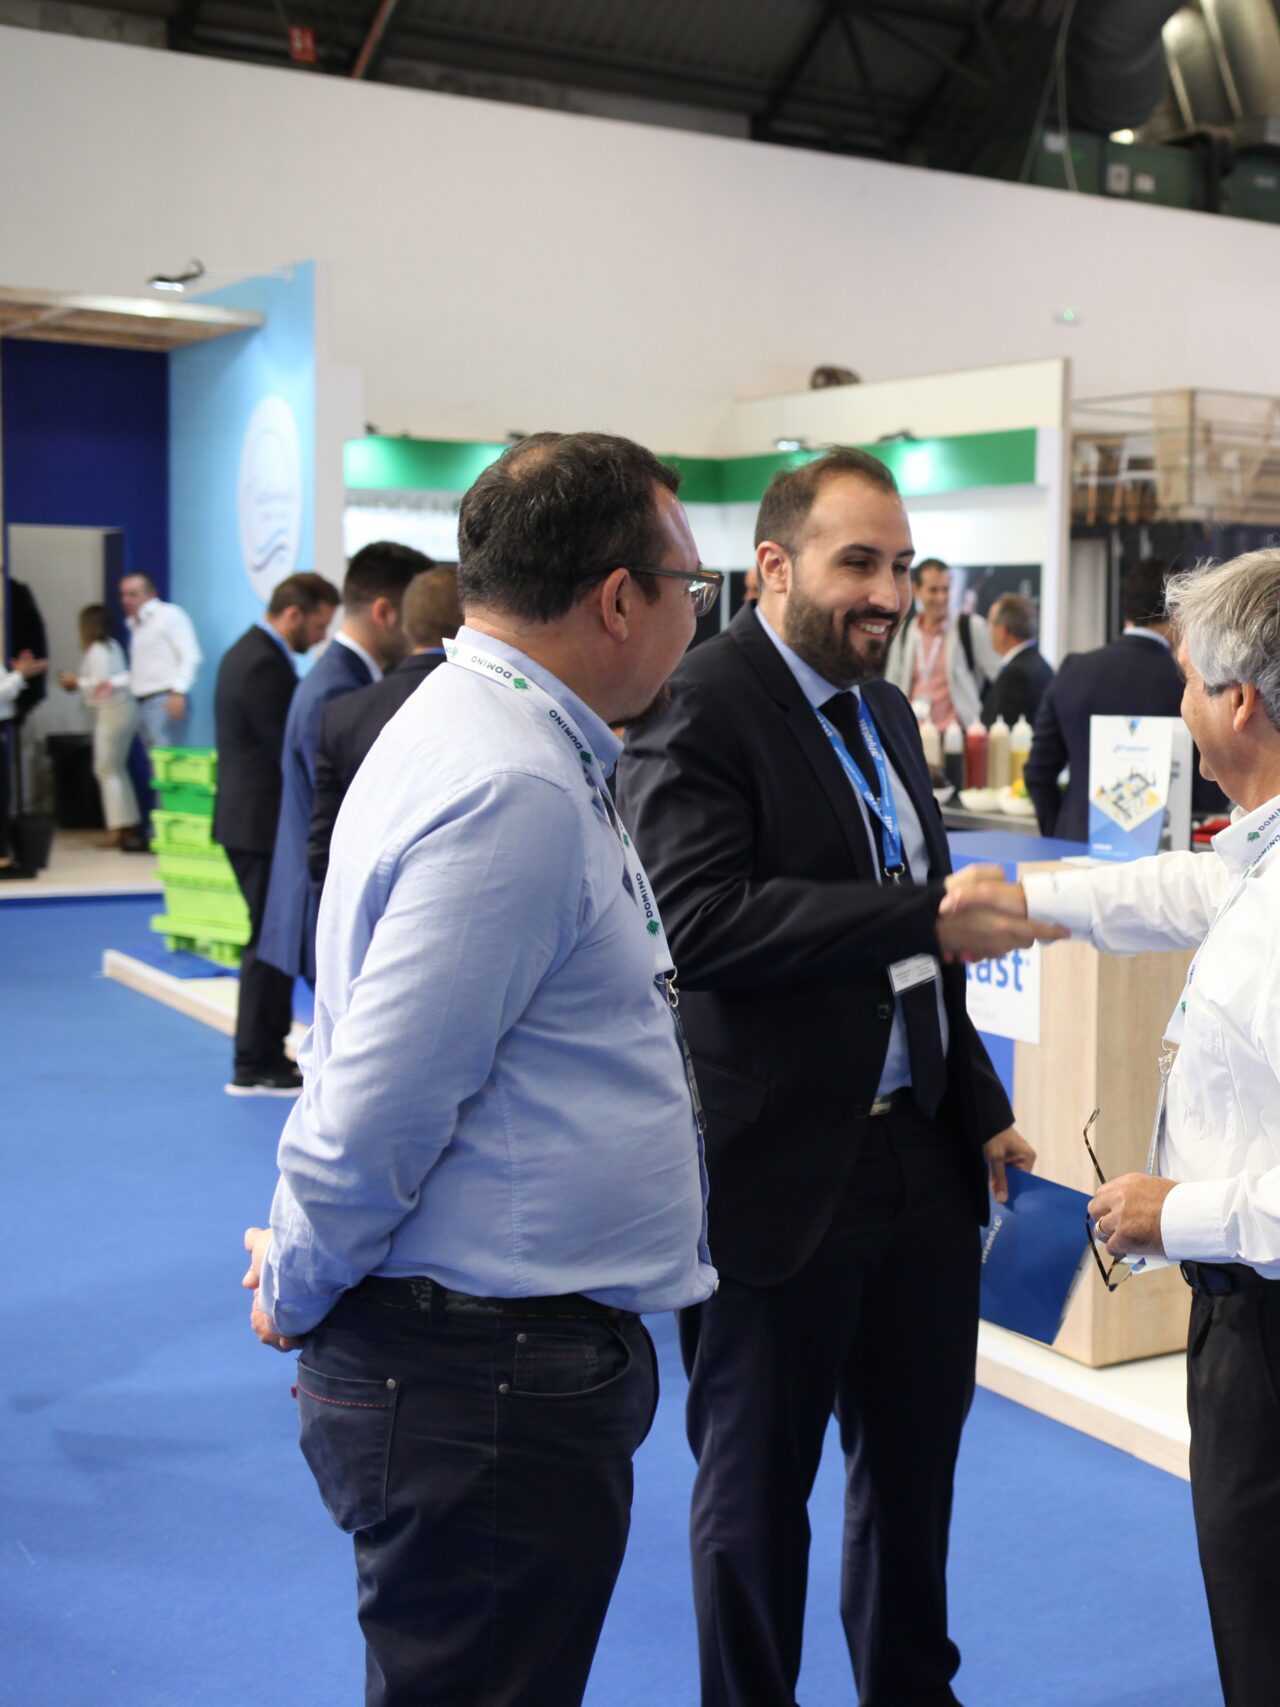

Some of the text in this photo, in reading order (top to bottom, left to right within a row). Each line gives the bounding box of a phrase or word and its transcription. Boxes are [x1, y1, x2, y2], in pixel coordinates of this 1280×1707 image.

[470, 655, 513, 680] DOMINO
[548, 709, 583, 750] DOMINO
[635, 872, 653, 918] DOMINO
